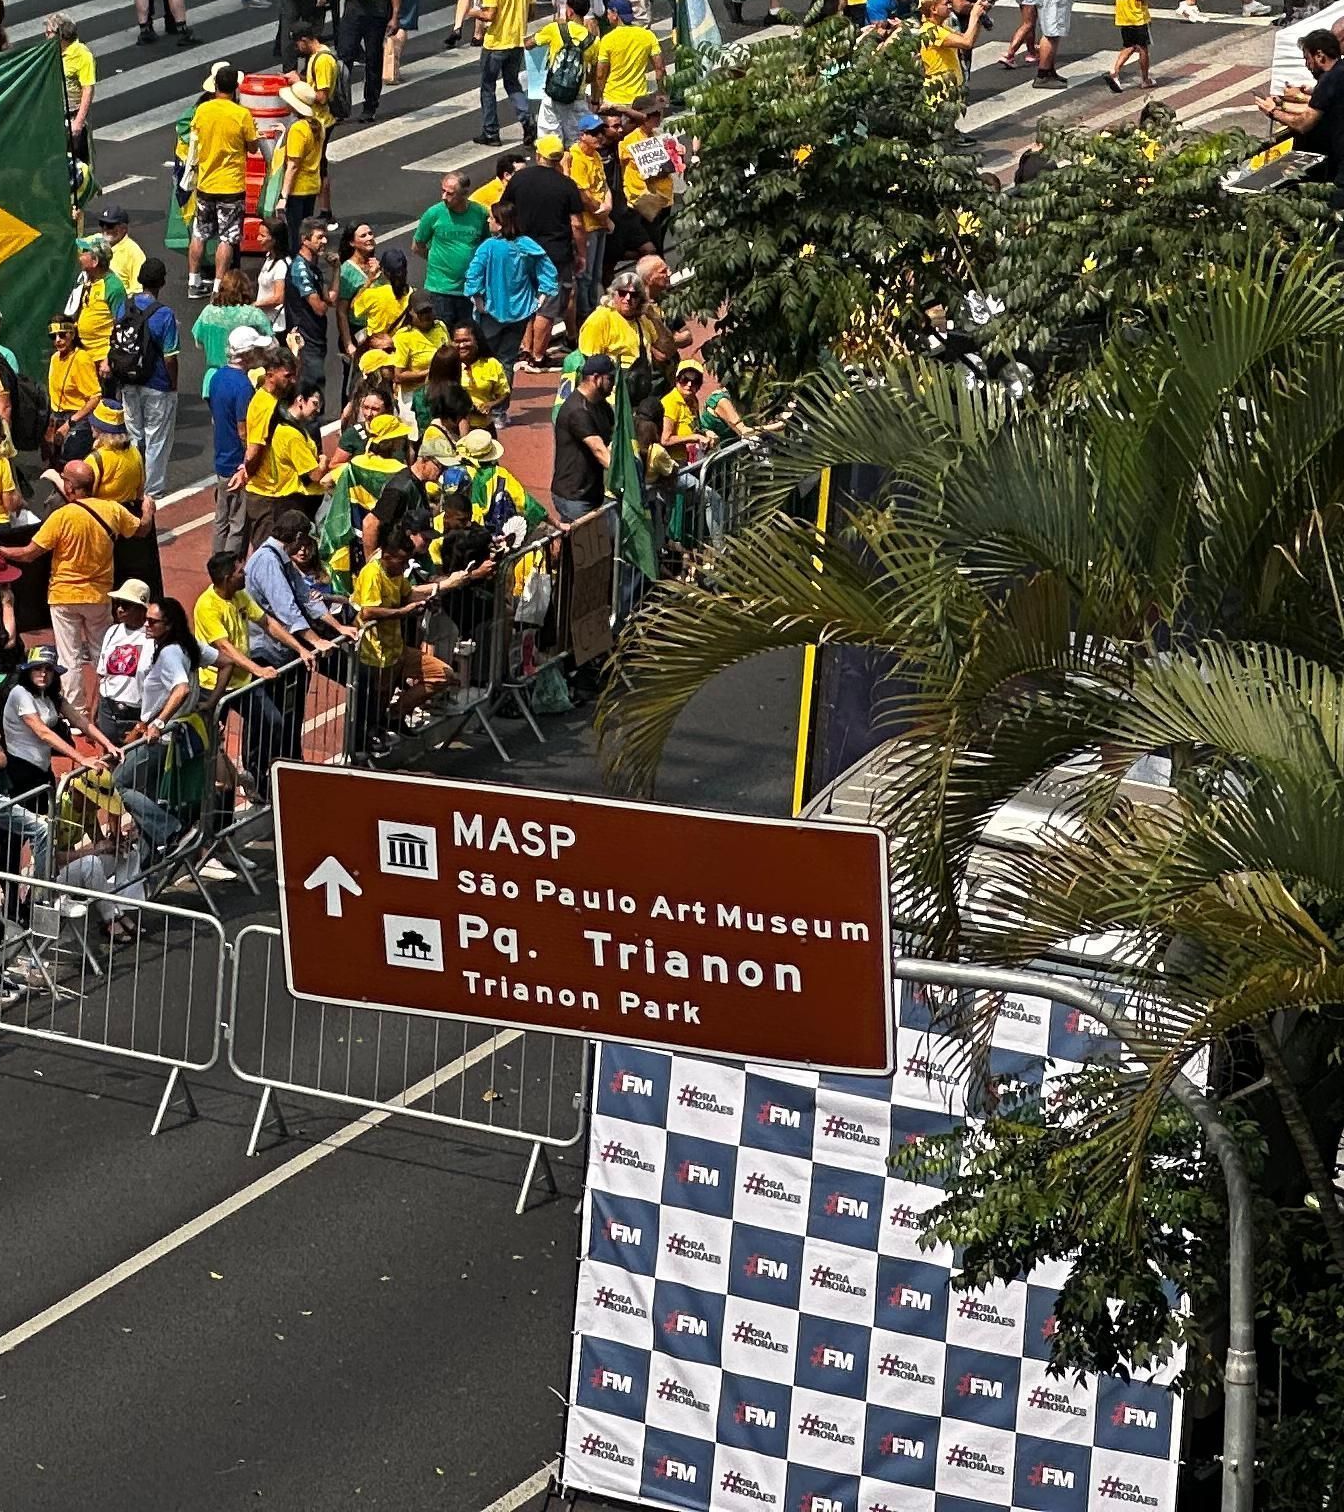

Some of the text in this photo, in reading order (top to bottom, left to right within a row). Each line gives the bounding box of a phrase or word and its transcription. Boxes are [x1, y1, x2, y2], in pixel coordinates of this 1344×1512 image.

[453, 811, 576, 860] MASP
[457, 869, 870, 943] São Paulo Art Museum
[458, 913, 802, 993] Pq. Trianon
[462, 970, 702, 1025] Trianon Park
